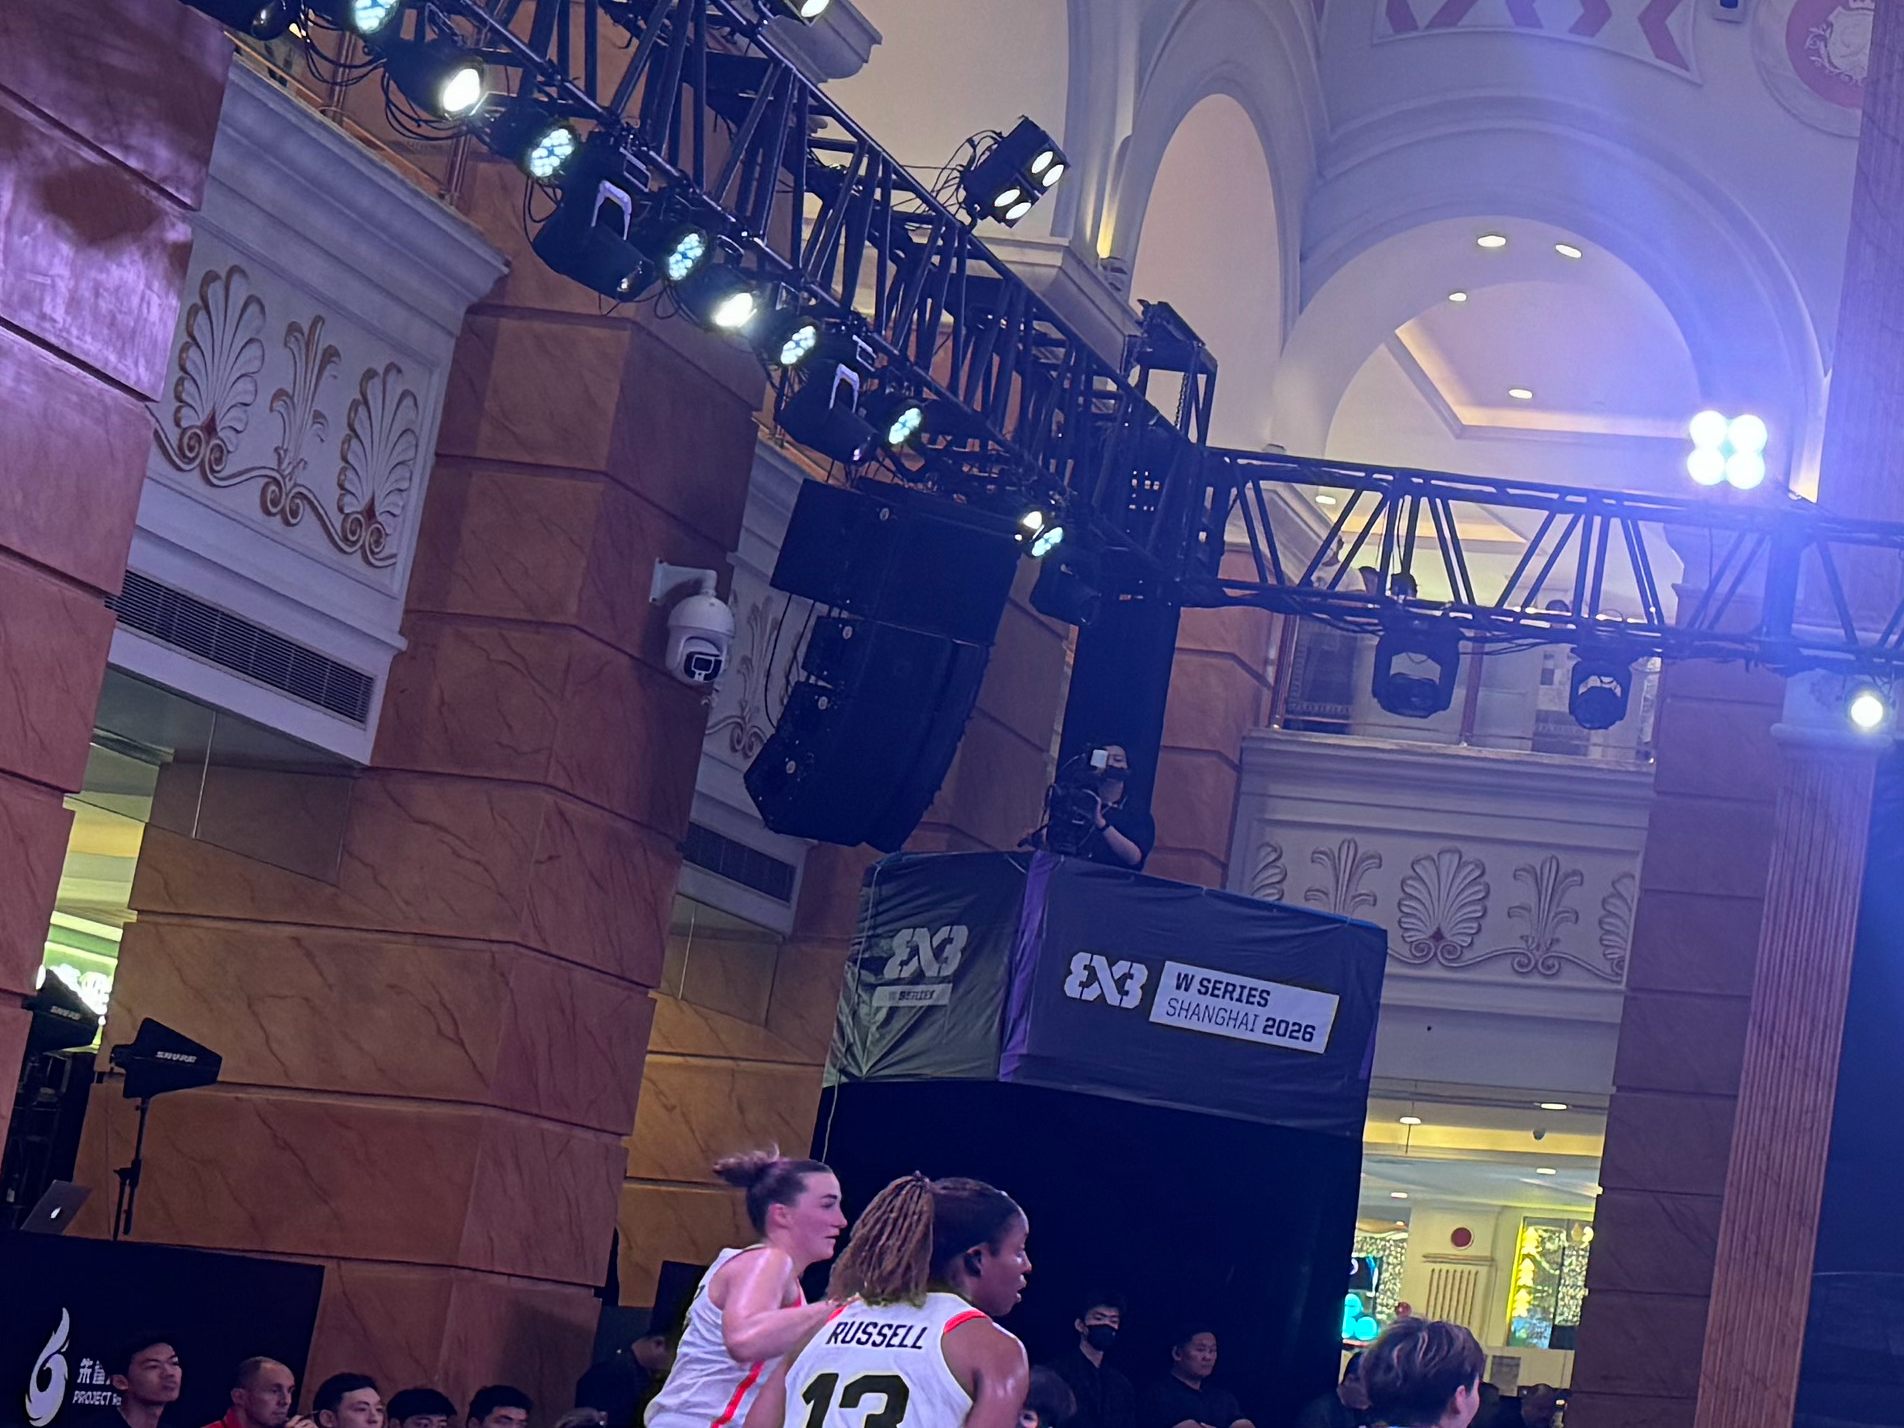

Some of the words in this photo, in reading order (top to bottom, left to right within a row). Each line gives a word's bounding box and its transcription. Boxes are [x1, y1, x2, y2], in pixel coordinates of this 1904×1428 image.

[1176, 972, 1195, 992] W
[1197, 977, 1271, 1008] SERIES
[1166, 998, 1259, 1032] SHANGHAI
[1262, 1017, 1316, 1042] 2026
[155, 1050, 197, 1063] SHURE
[825, 1321, 928, 1350] RUSSELL
[72, 1390, 112, 1406] PROJECT
